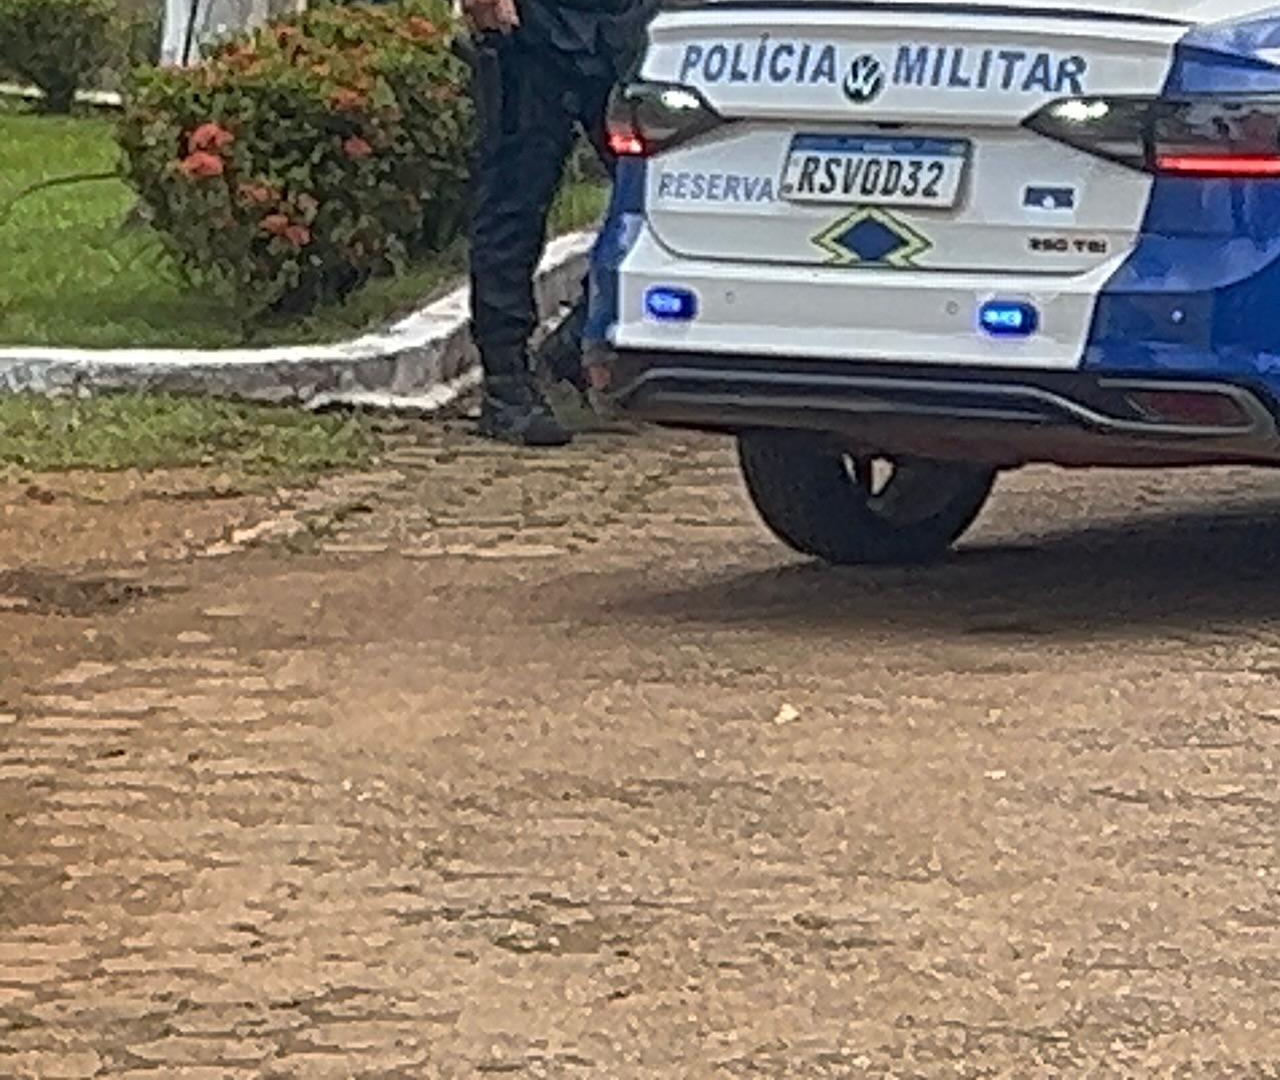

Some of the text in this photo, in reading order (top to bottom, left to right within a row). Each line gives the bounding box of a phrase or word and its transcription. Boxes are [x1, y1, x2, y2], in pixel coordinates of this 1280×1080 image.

[679, 32, 1088, 94] POLÍCIA MILITAR
[657, 172, 774, 202] RESERVA
